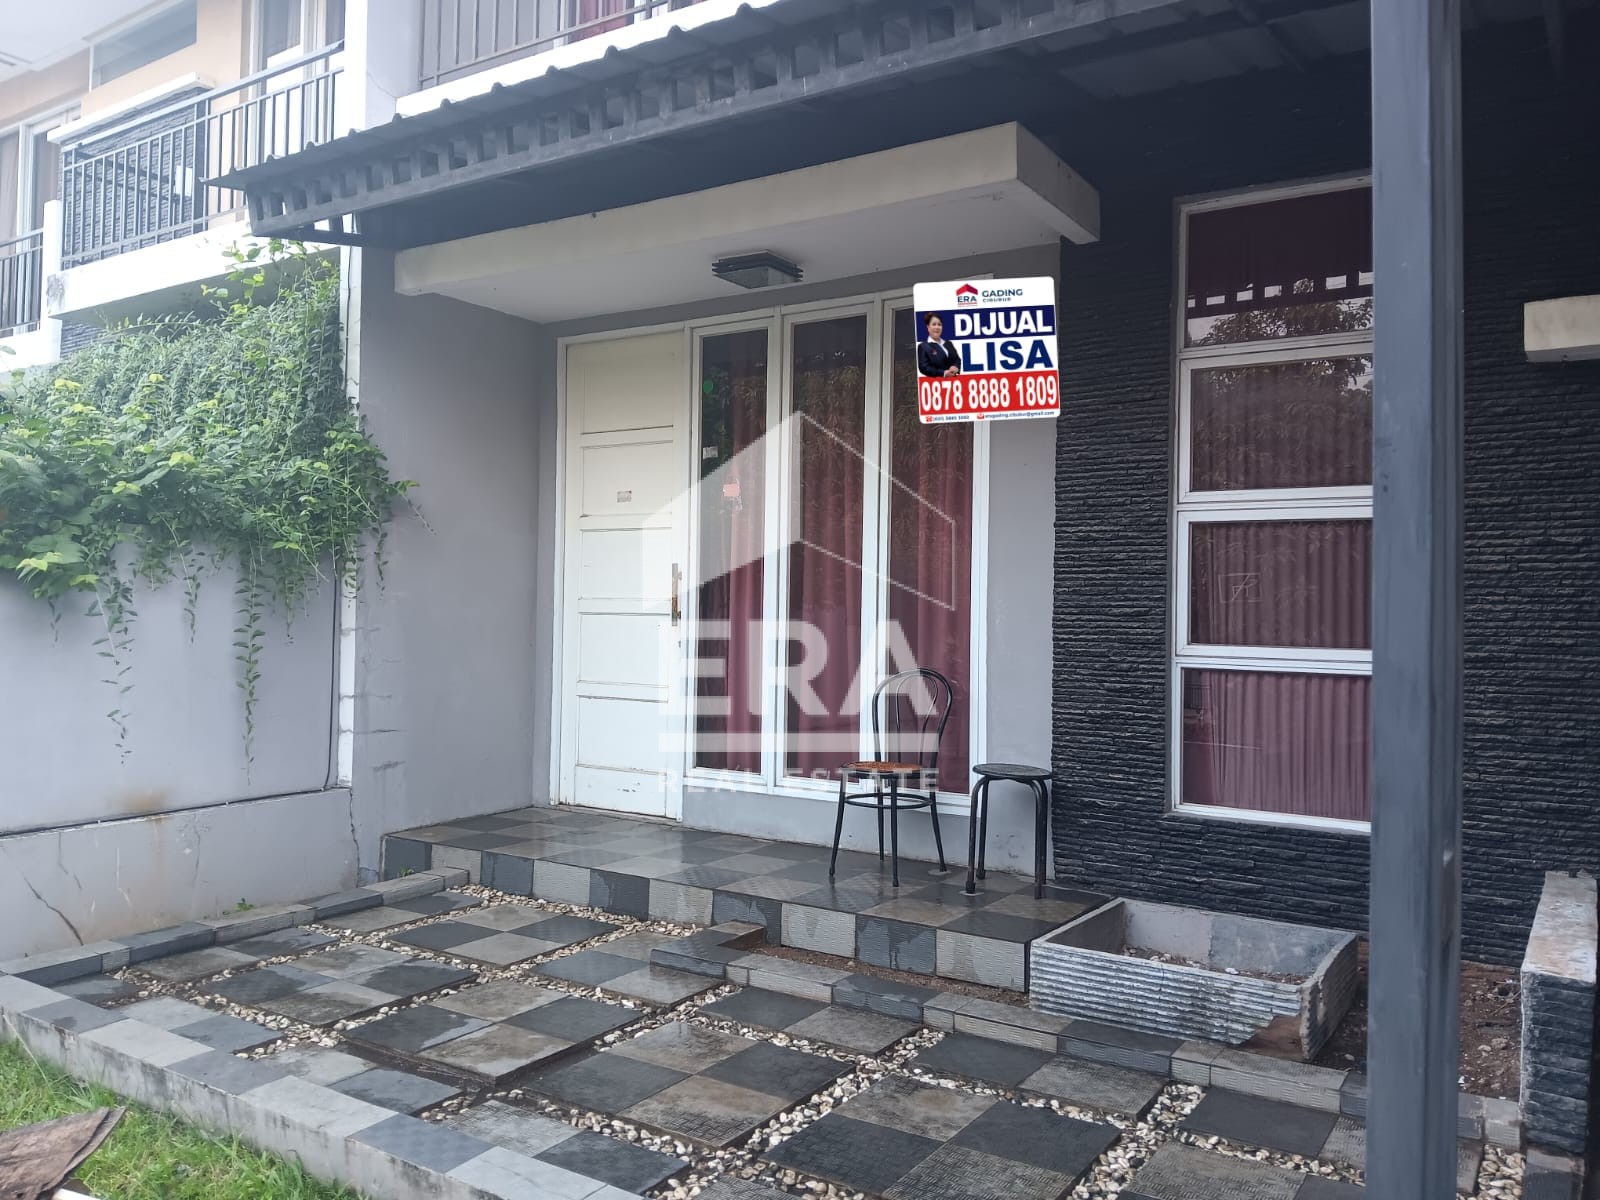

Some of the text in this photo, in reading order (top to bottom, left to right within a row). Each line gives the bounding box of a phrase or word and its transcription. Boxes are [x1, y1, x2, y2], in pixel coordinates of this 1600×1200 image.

[957, 295, 977, 303] ERA
[981, 288, 1023, 298] GADING
[953, 309, 1053, 337] DIJUAL
[961, 339, 1054, 372] LISA
[921, 375, 1057, 412] 0878 8888 1809
